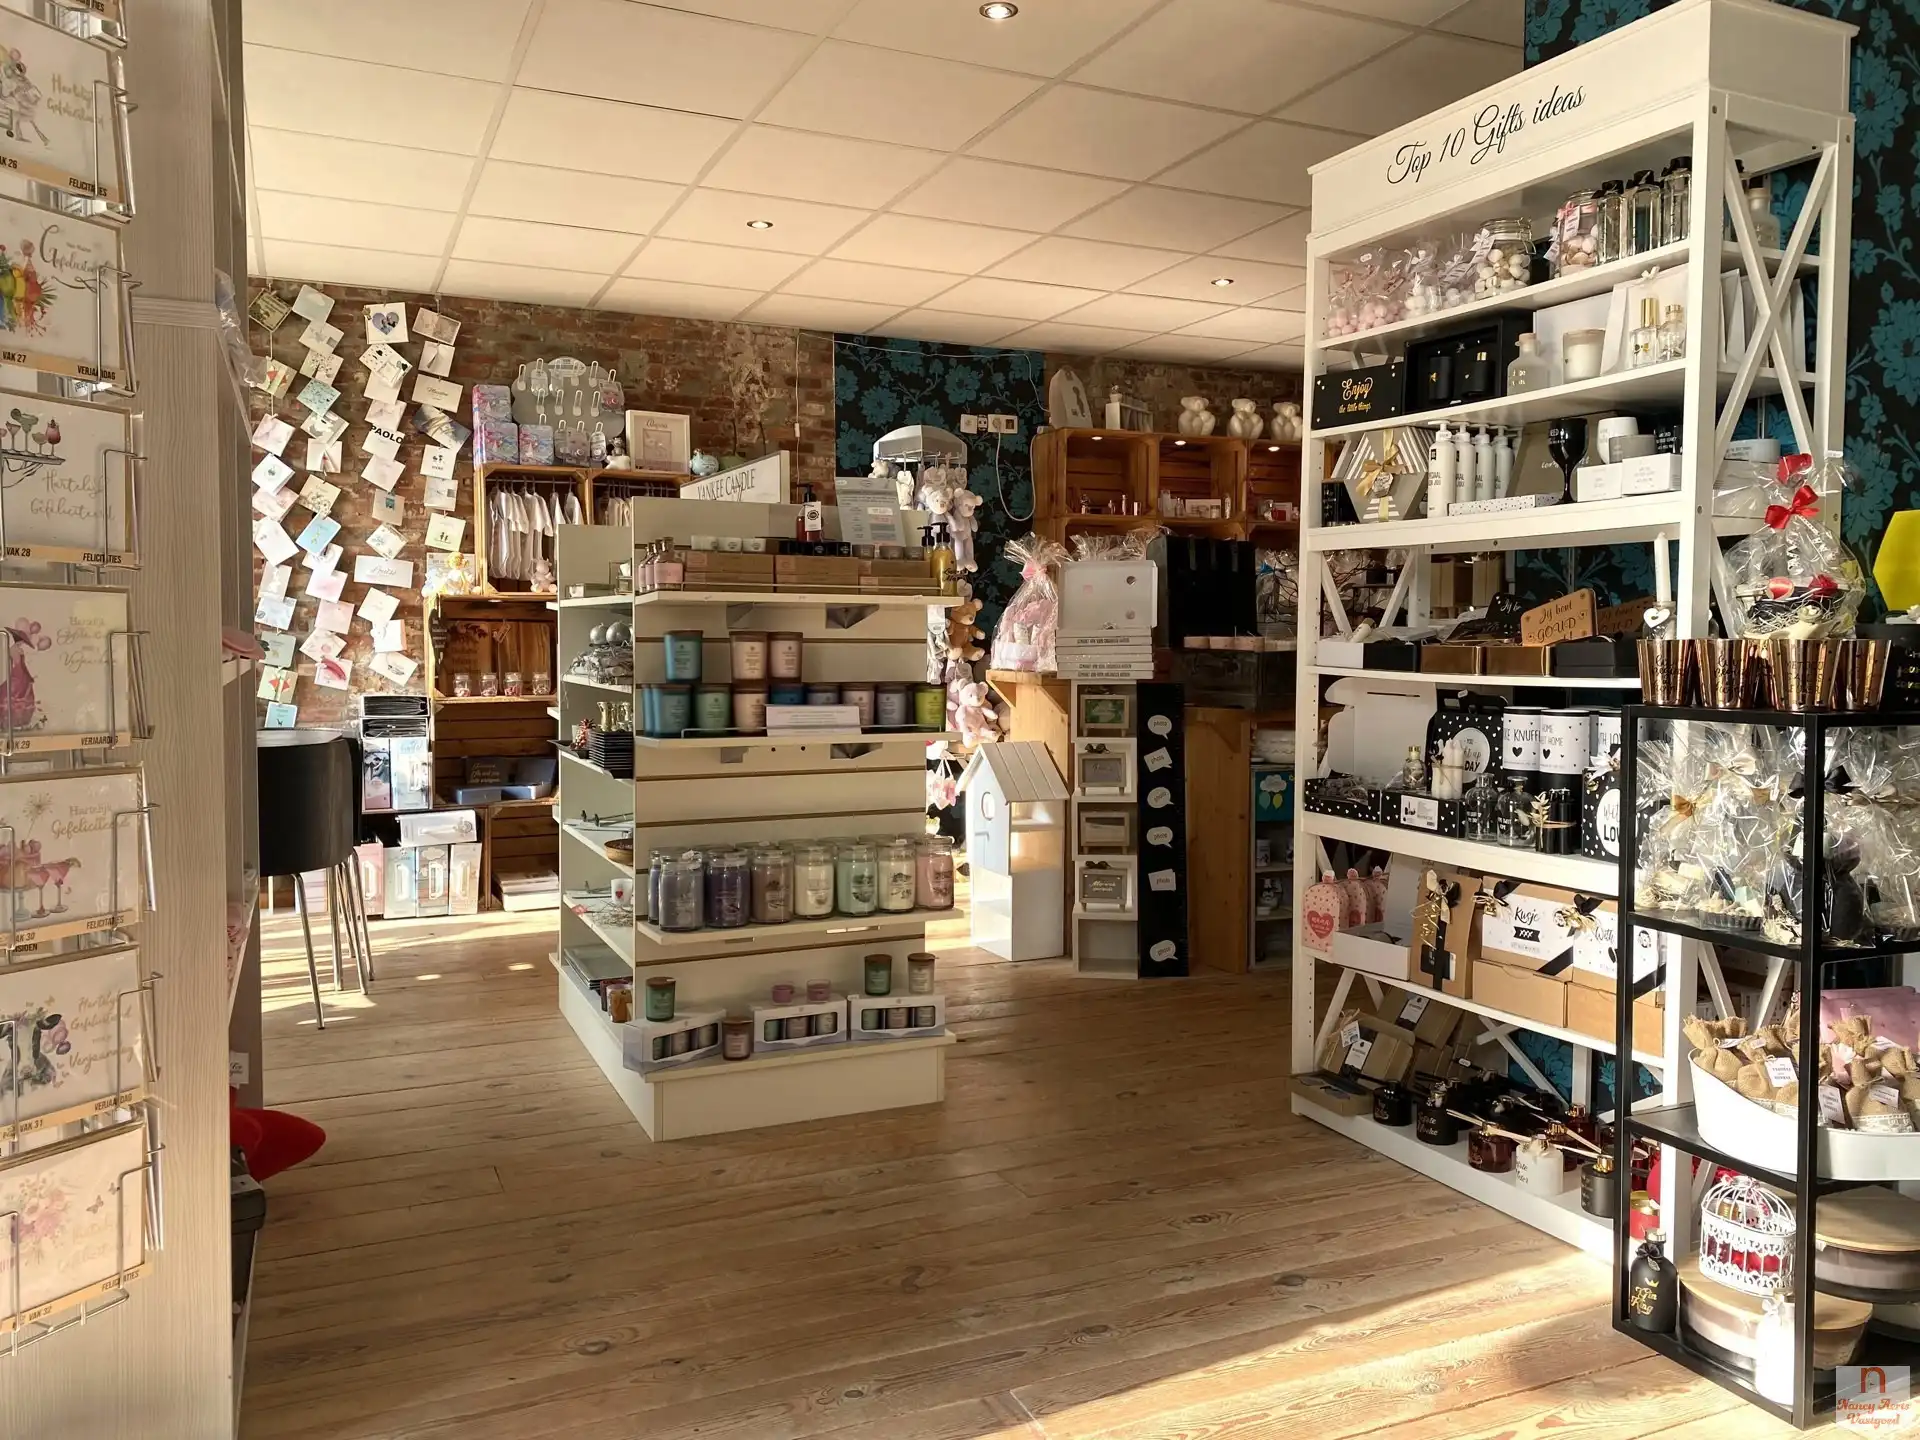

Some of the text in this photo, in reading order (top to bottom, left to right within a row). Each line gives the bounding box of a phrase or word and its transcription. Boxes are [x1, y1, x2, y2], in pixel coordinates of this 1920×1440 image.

[1387, 85, 1587, 184] Top 10 Gifts ideas
[8, 158, 18, 169] 26
[2, 351, 27, 363] VAK 27
[1341, 377, 1374, 400] Enjoy
[370, 425, 404, 444] PAOLO
[697, 468, 756, 502] YANKEE CANDLE
[6, 547, 31, 557] VAK 28
[21, 740, 31, 749] 29
[1464, 760, 1481, 772] DAY
[1514, 906, 1540, 926] Kusje
[26, 932, 36, 941] 30
[20, 1119, 43, 1133] VAK 31
